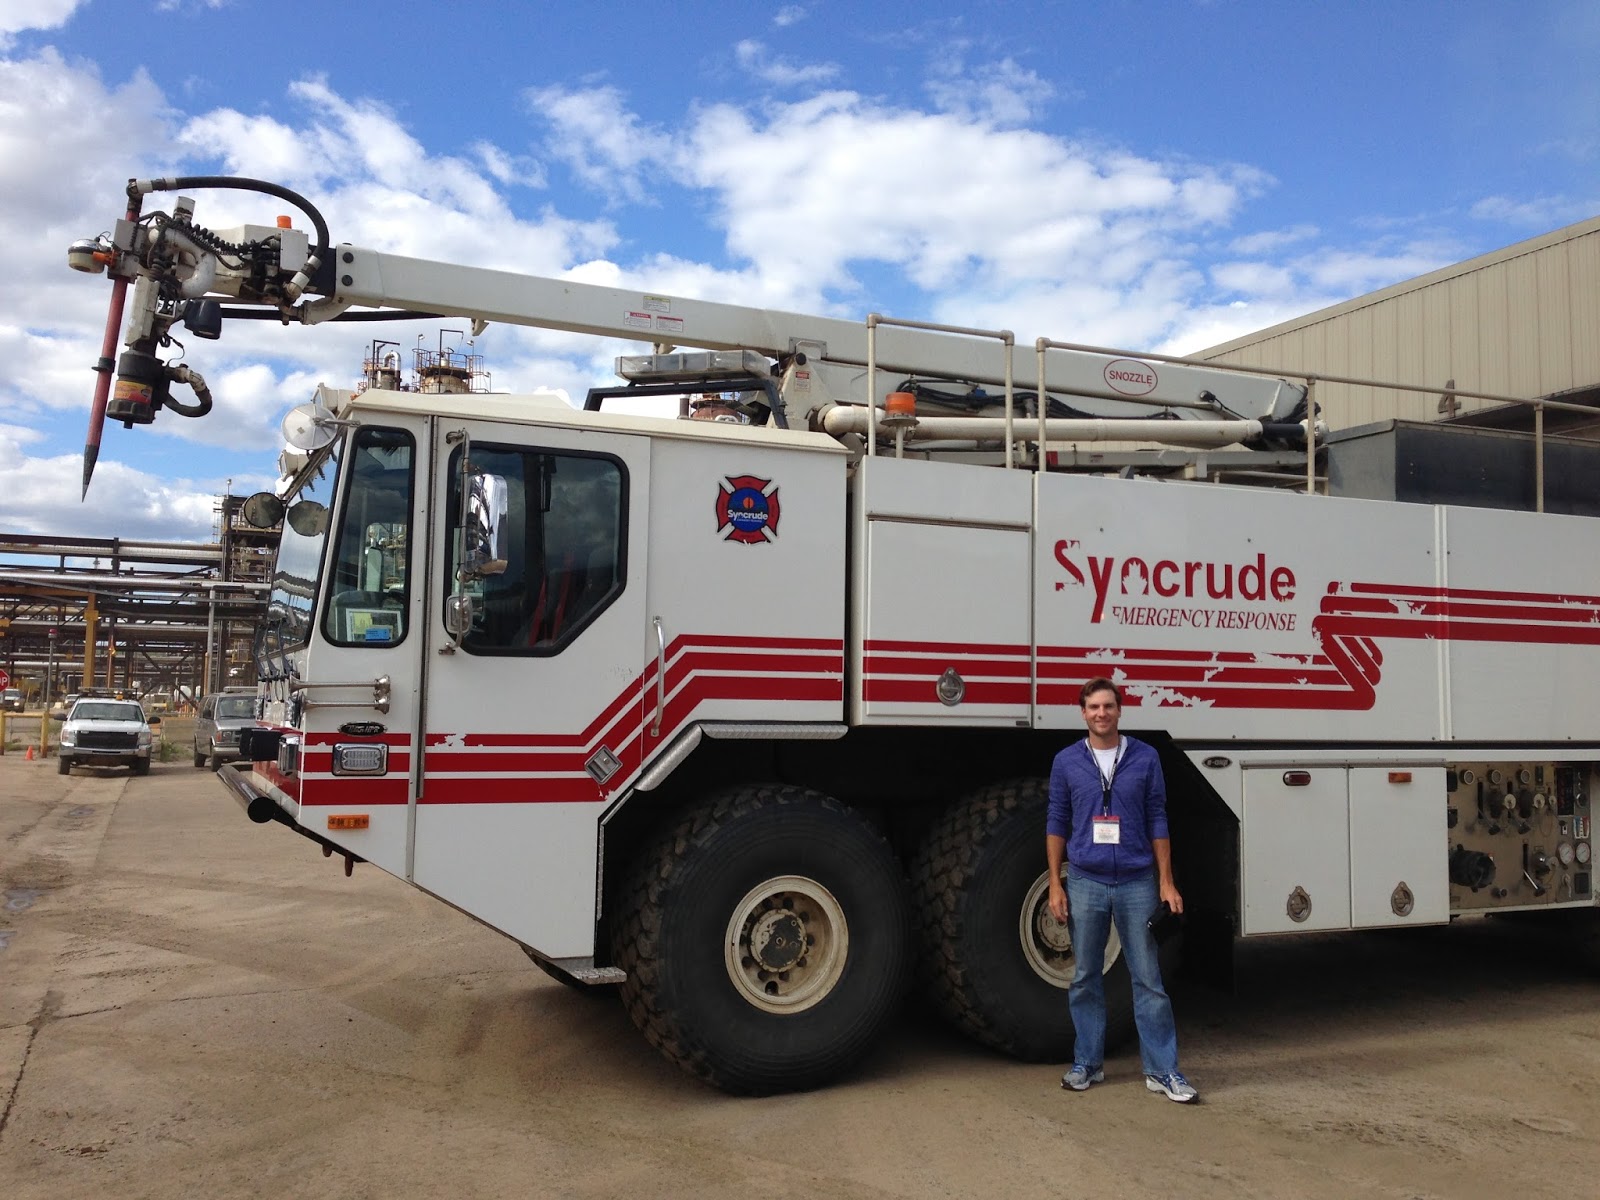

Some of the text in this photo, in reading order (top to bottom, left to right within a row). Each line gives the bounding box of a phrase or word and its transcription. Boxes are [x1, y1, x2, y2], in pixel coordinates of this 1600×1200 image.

[1109, 370, 1152, 384] SNOZZLE
[1438, 379, 1462, 418] 4
[727, 510, 768, 521] Syncrude
[1054, 539, 1296, 623] Syncrude
[1216, 611, 1297, 631] RESPONSE
